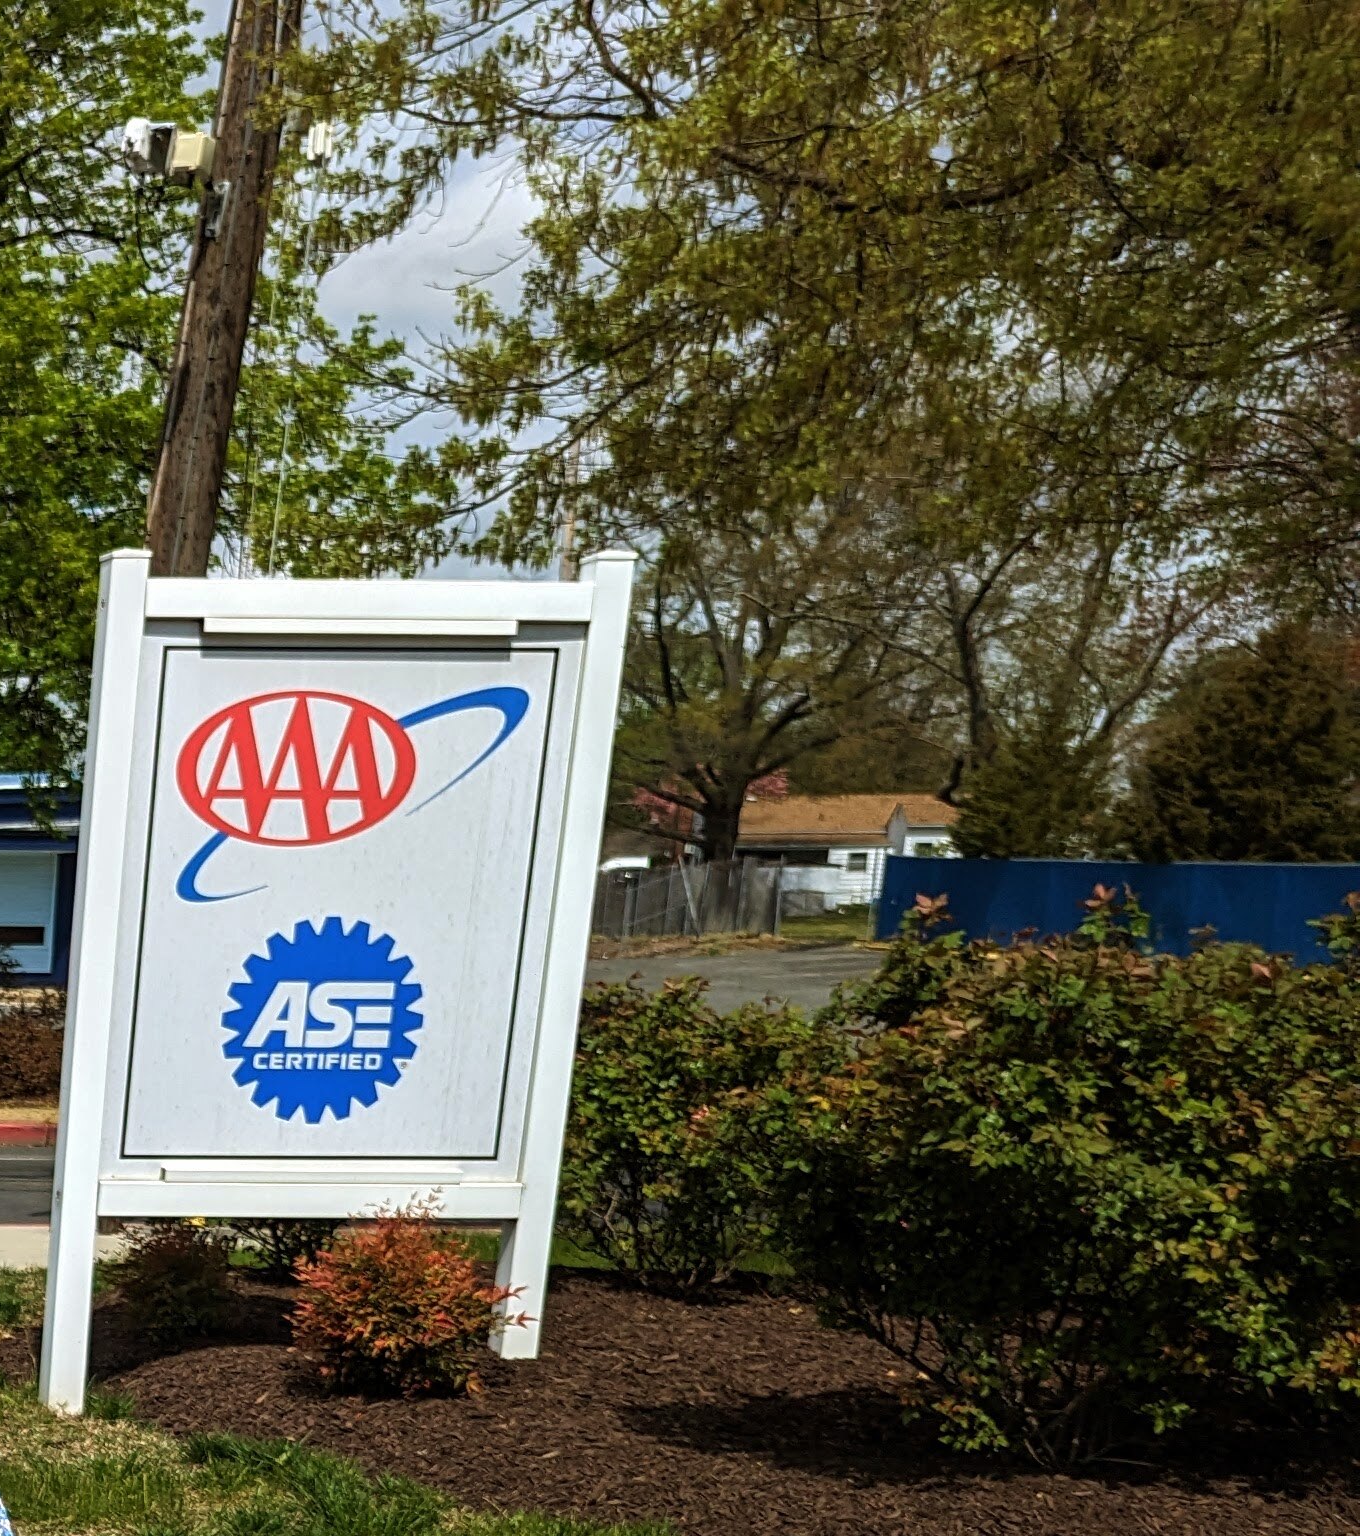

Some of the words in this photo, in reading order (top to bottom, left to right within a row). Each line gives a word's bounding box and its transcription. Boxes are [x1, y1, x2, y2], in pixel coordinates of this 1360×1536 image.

[200, 692, 392, 844] AAA
[242, 981, 396, 1049] ASE
[252, 1053, 383, 1070] CERTIFIED
